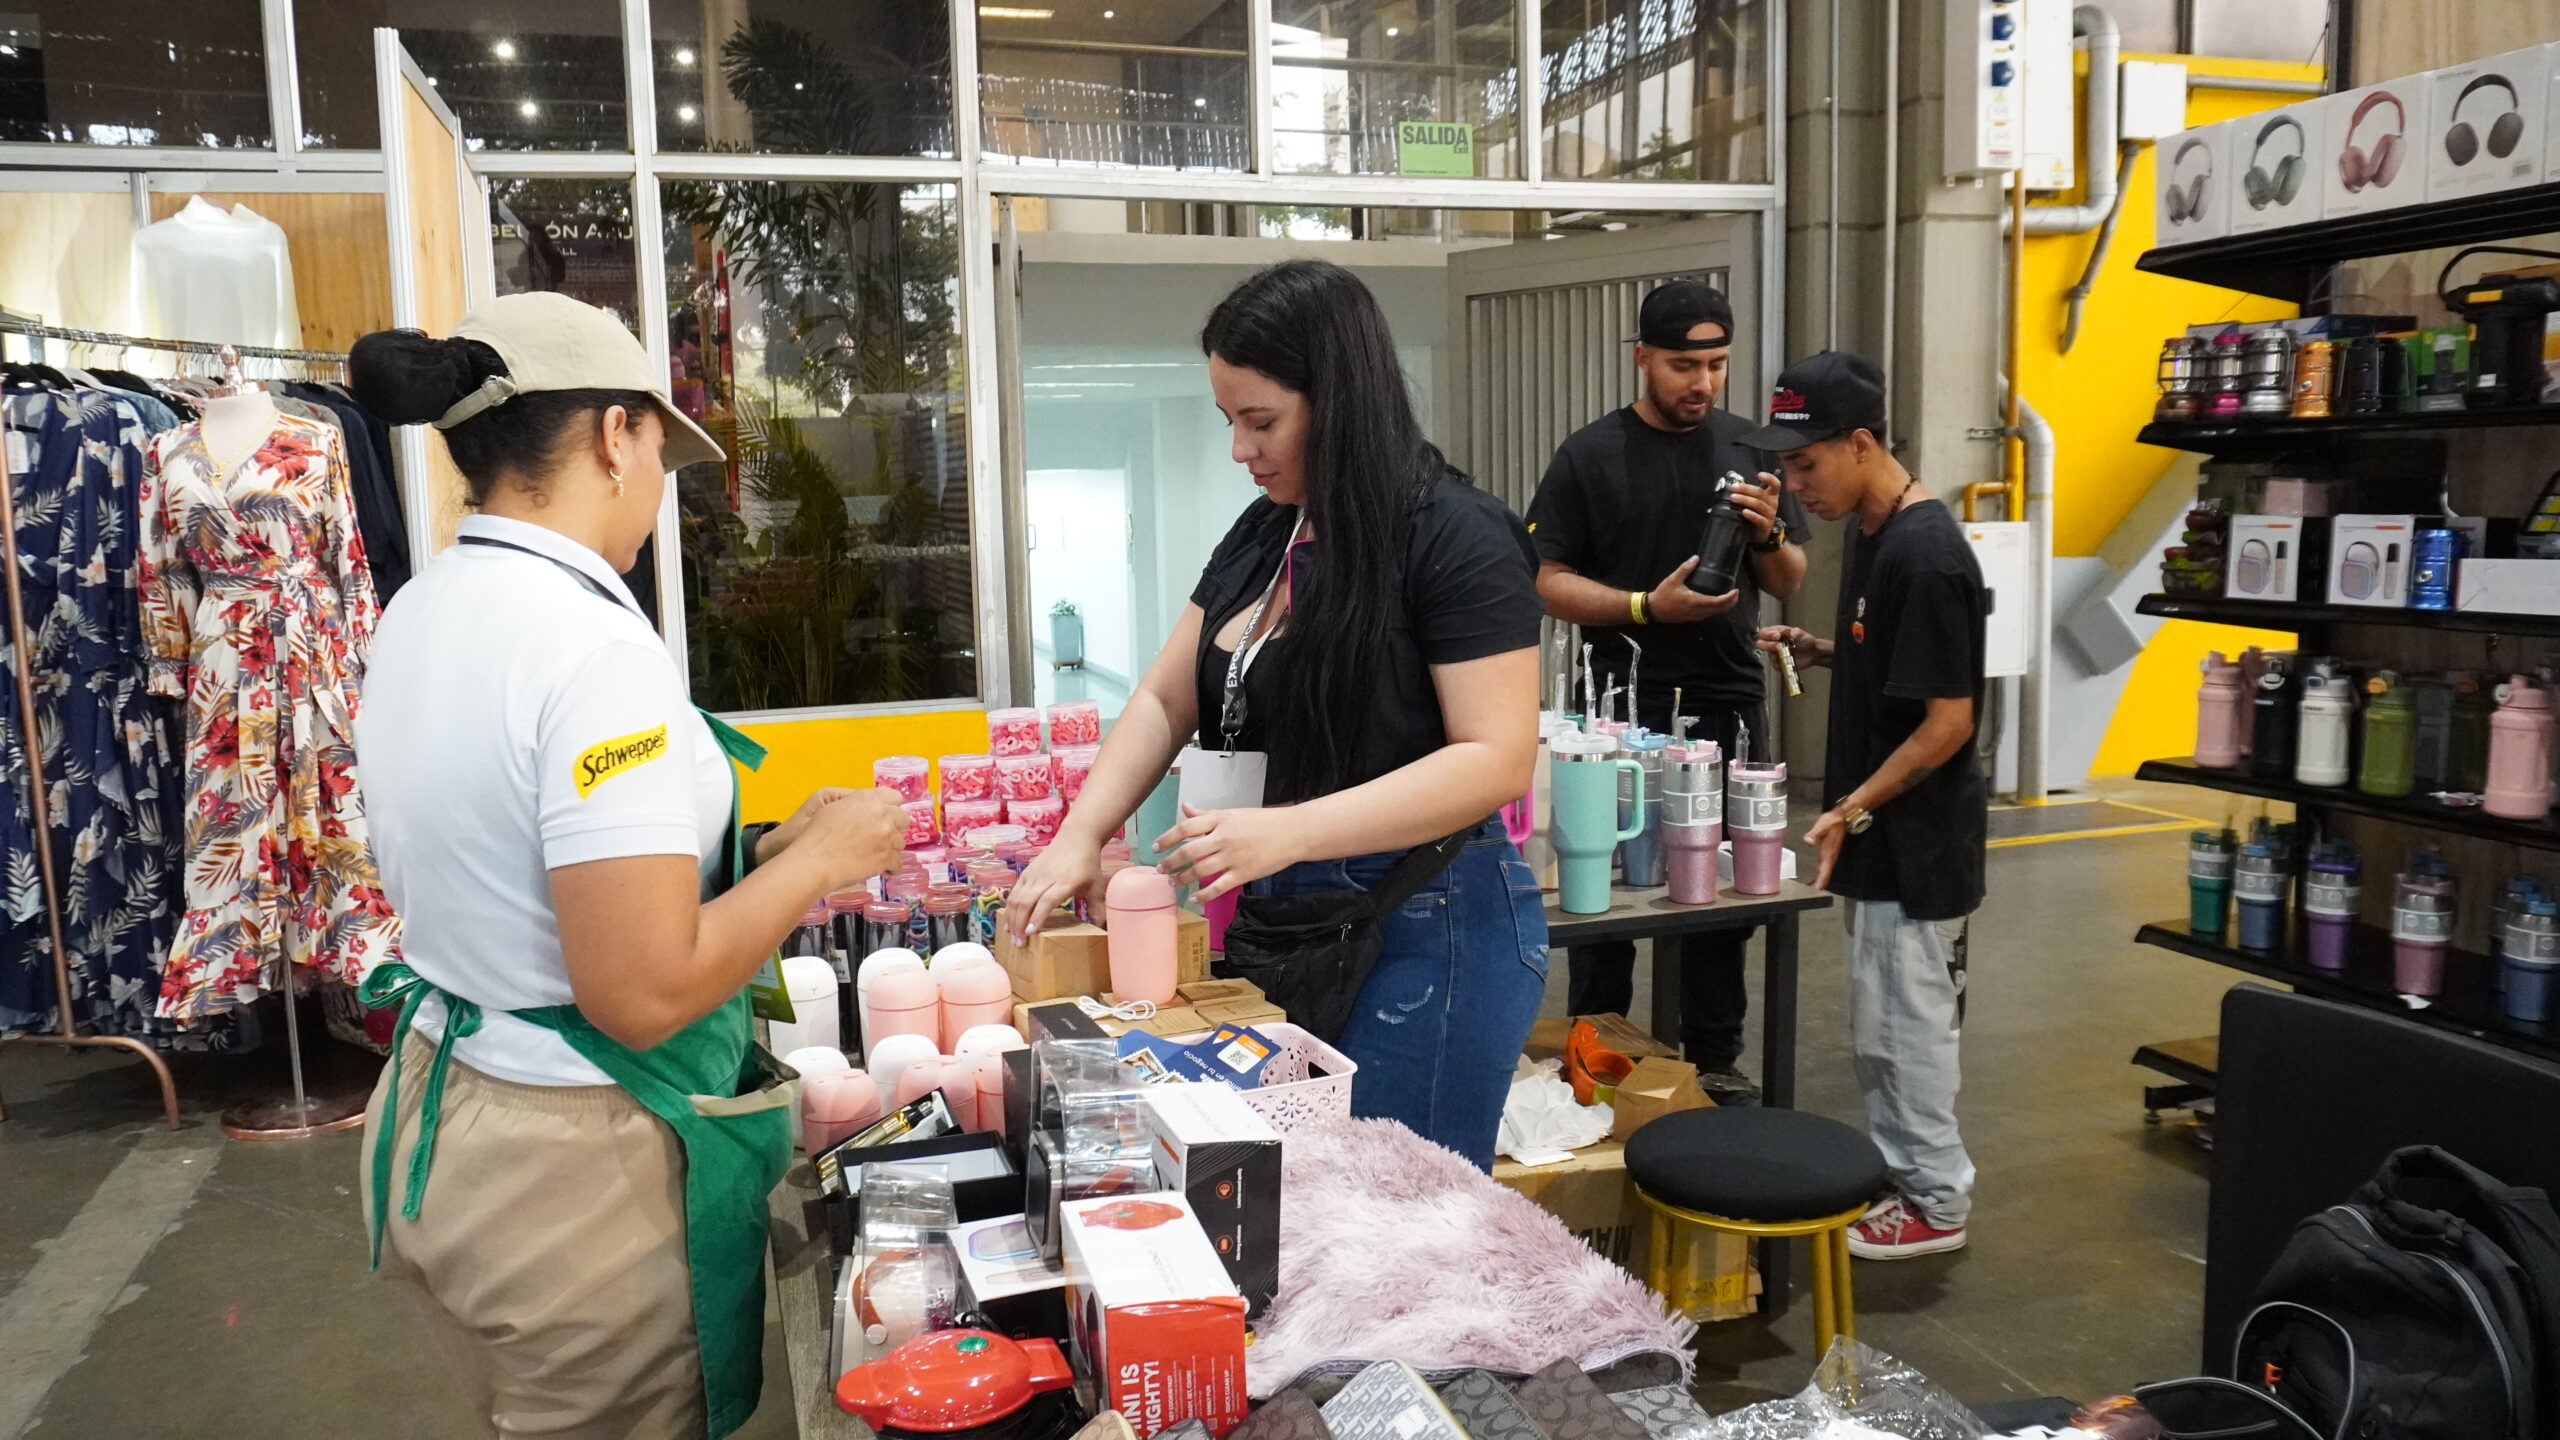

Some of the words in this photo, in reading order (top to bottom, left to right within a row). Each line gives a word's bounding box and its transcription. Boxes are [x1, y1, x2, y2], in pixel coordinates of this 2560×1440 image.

[1403, 125, 1469, 146] SALIDA
[1226, 603, 1265, 688] EXPOSITORES
[582, 732, 665, 787] Schweppes
[1183, 1050, 1209, 1069] negocio
[1120, 1363, 1140, 1385] IS
[1143, 1360, 1162, 1439] MIGHTY!
